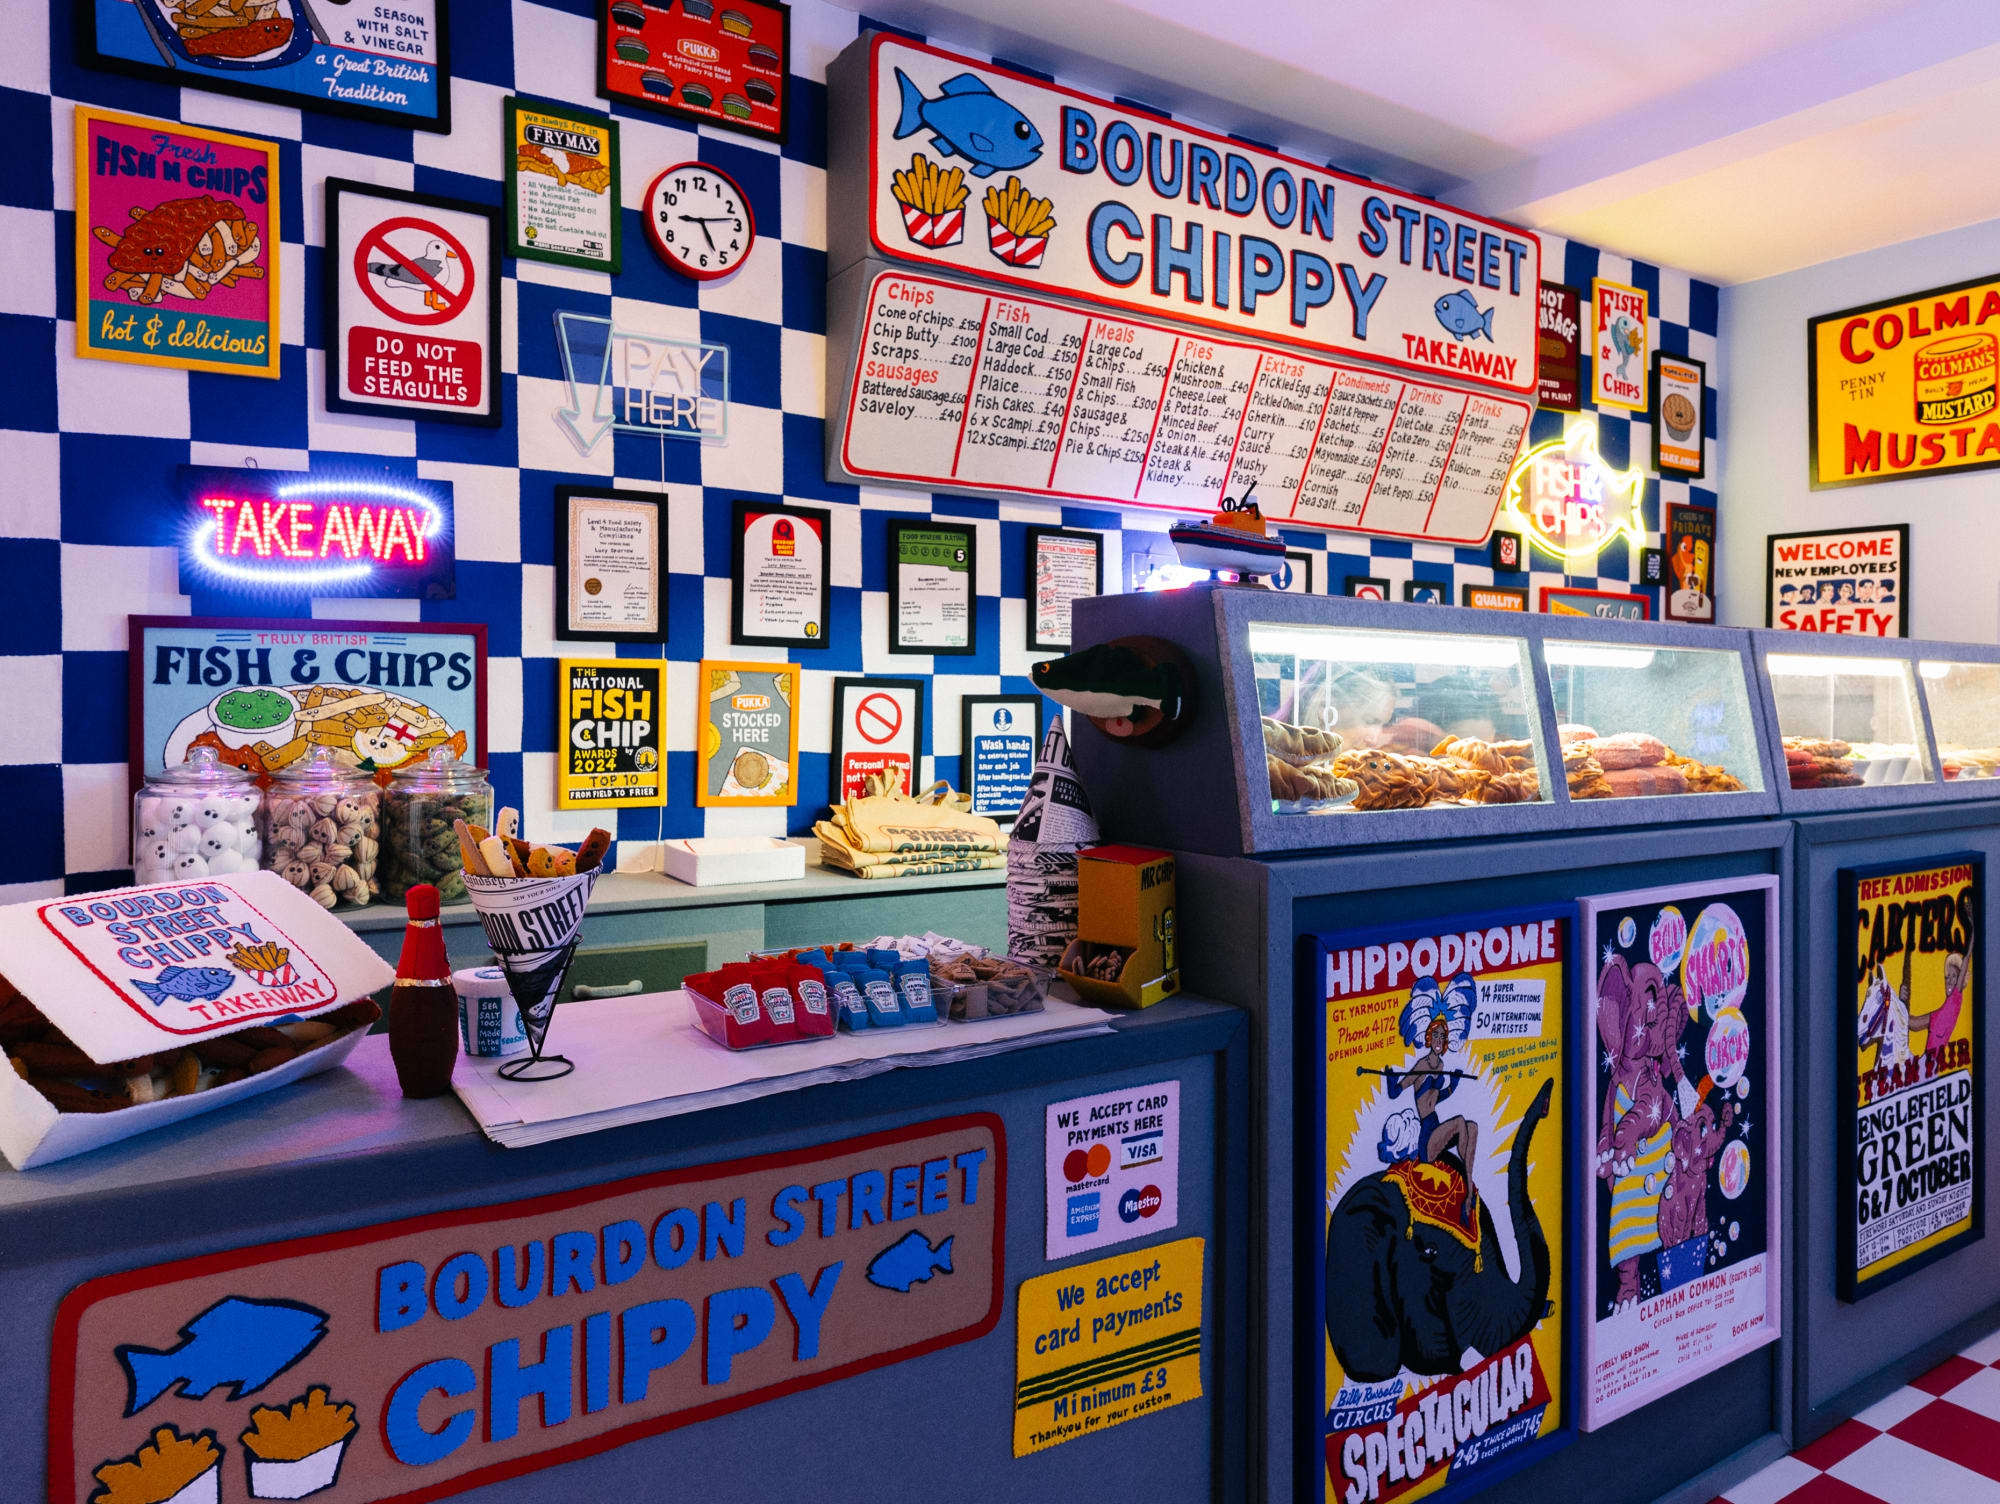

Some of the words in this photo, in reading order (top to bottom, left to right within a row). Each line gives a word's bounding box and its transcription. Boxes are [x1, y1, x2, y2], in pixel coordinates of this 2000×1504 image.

[374, 6, 425, 27] SEASON
[357, 18, 391, 34] WITH
[396, 24, 429, 41] SALT
[344, 31, 356, 44] &
[362, 35, 425, 56] VINEGAR
[683, 42, 716, 59] PUKKA
[316, 54, 326, 66] a
[333, 53, 370, 77] Great
[374, 59, 430, 84] British
[323, 77, 409, 106] Tradition
[151, 134, 218, 165] Fresh
[533, 128, 598, 153] FRYMAX
[95, 135, 158, 181] FISH
[163, 160, 181, 183] N
[188, 161, 267, 204] CHIPS
[1060, 104, 1335, 242] BOURDON
[1358, 196, 1528, 296] STREET
[1086, 200, 1388, 341] CHIPPY
[1540, 288, 1565, 309] HOT
[1598, 287, 1644, 332] FISH
[878, 304, 906, 319] Cone
[909, 309, 922, 324] of
[996, 302, 1030, 323] Fish
[101, 309, 136, 343] hot
[145, 313, 163, 350] &
[169, 320, 266, 355] delicious
[874, 323, 902, 343] Chip
[906, 326, 939, 348] Butty
[989, 321, 1022, 339] Small
[1025, 328, 1049, 343] Cod
[1095, 322, 1135, 343] Meals
[376, 336, 404, 355] DO
[416, 343, 456, 363] NOT
[872, 341, 919, 364] Scraps
[1089, 340, 1120, 360] Large
[1123, 346, 1143, 360] Cod
[1184, 341, 1213, 360] Pies
[1402, 332, 1518, 381] TAKEAWAY
[1601, 345, 1611, 360] &
[365, 357, 412, 377] FEED
[424, 365, 463, 384] THE
[625, 338, 715, 393] PAY
[866, 361, 939, 386] Sausages
[1265, 356, 1305, 377] Extras
[363, 376, 468, 402] SEAGULLS
[980, 375, 1019, 393] Plaice
[1338, 372, 1391, 394] Condiments
[1603, 372, 1640, 399] CHIPS
[1840, 371, 1887, 391] PENNY
[1410, 388, 1443, 405] Drinks
[1849, 387, 1875, 401] TIN
[1922, 391, 1995, 420] MUSTARD
[624, 387, 717, 431] HERE
[860, 398, 915, 420] Saveloy
[1472, 399, 1502, 418] Drinks
[1161, 414, 1196, 430] Minced
[1197, 420, 1219, 432] Beef
[1319, 432, 1355, 451] Ketchup
[1535, 460, 1584, 498] FISH
[203, 498, 314, 558] TAKE
[319, 504, 432, 561] AWAY
[1777, 538, 1894, 562] WELCOME
[1775, 567, 1808, 578] NEW
[1810, 561, 1897, 577] EMPLOYEES
[1474, 593, 1521, 609] QUALITY
[1779, 609, 1893, 637] SAFETY
[257, 633, 306, 645] TRULY
[312, 634, 368, 645] BRITISH
[153, 645, 274, 687] FISH
[290, 649, 320, 684] &
[335, 648, 472, 691] CHIPS
[576, 668, 597, 677] THE
[573, 677, 644, 689] NATIONAL
[572, 689, 651, 720] FISH
[736, 697, 768, 708] PUKKA
[722, 712, 781, 728] STOCKED
[571, 719, 650, 750] CHIP
[583, 729, 591, 740] &
[732, 728, 769, 742] HERE
[981, 740, 1004, 750] Wash
[1006, 739, 1030, 751] hands
[574, 749, 617, 759] AWARDS
[574, 759, 617, 772] 2024
[589, 775, 617, 787] TOP
[623, 774, 639, 785] 10
[570, 791, 592, 800] FROM
[592, 790, 612, 798] FIELD
[614, 788, 626, 797] TO
[629, 788, 654, 797] FRIER
[1893, 865, 1972, 897] ADMISSION
[59, 885, 229, 928] BOURDON
[107, 905, 229, 945] STREET
[118, 922, 263, 970] CHIPPY
[1652, 918, 1685, 965] BILLY
[1326, 919, 1556, 998] HIPPODROME
[188, 977, 326, 1022] TAKEAWAY
[1480, 985, 1491, 1002] 14
[1493, 983, 1514, 992] SUPER
[1492, 993, 1541, 1003] PRESENTATIONS
[479, 1011, 500, 1020] SALT
[482, 1001, 498, 1010] SEA
[1333, 1009, 1347, 1023] GT.
[1349, 997, 1399, 1019] YARMOUTH
[1338, 1027, 1370, 1045] Phone
[1372, 1016, 1396, 1035] 4172
[1476, 1013, 1490, 1029] 50
[1492, 1012, 1542, 1022] INTERNATIONAL
[1491, 1023, 1528, 1034] ARTISTES
[1328, 1046, 1364, 1062] OPENING
[1366, 1040, 1384, 1052] JUNE
[1708, 1030, 1749, 1072] CIRCUS
[1057, 1110, 1079, 1129] WE
[1090, 1101, 1133, 1122] ACCEPT
[1137, 1095, 1168, 1112] CARD
[1858, 1078, 1971, 1145] ENGLEFIELD
[1068, 1121, 1129, 1147] PAYMENTS
[1134, 1114, 1163, 1131] HERE
[1128, 1142, 1157, 1159] VISA
[1857, 1104, 1970, 1187] GREEN
[1066, 1175, 1110, 1194] mastercard
[1896, 1149, 1971, 1208] OCTOBER
[1125, 1194, 1160, 1214] Maestro
[1071, 1212, 1100, 1225] EXPRESS
[374, 1197, 747, 1334] BOURDON
[766, 1147, 988, 1248] STREET
[1057, 1285, 1085, 1312] We
[1096, 1259, 1161, 1299] accept
[1640, 1289, 1685, 1322] CLAPHAM
[1689, 1272, 1727, 1299] COMMON
[1034, 1318, 1080, 1355] card
[1093, 1290, 1183, 1343] payments
[1732, 1321, 1748, 1337] BOOK
[1750, 1314, 1765, 1327] NOW
[379, 1260, 844, 1467] CHIPPY
[1053, 1381, 1136, 1422] Minimum
[1141, 1367, 1167, 1394] £3
[1085, 1415, 1101, 1429] for
[1107, 1407, 1129, 1424] your
[1133, 1392, 1172, 1413] custom
[1333, 1401, 1395, 1429] CIRCUS
[1342, 1342, 1534, 1504] SPECTACULAR
